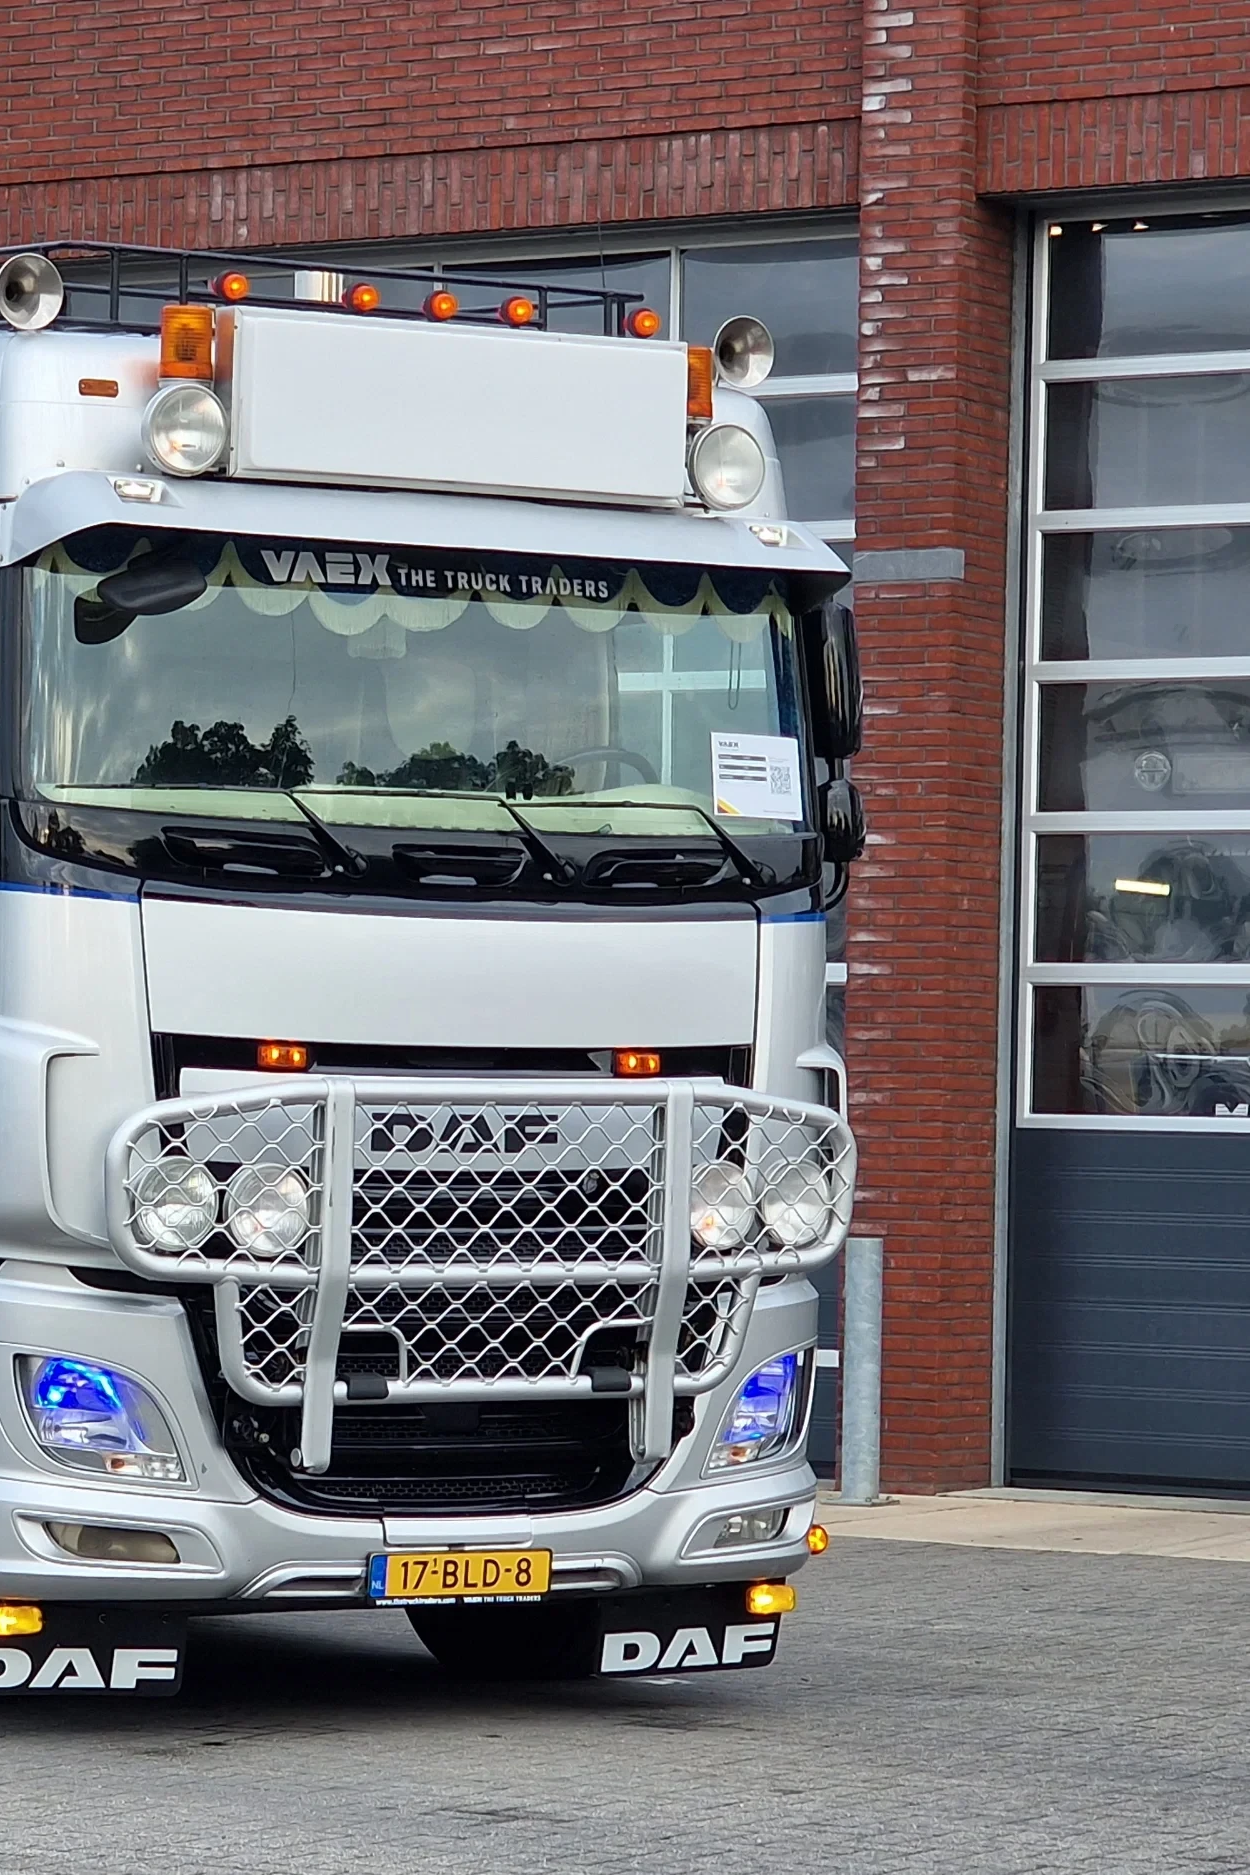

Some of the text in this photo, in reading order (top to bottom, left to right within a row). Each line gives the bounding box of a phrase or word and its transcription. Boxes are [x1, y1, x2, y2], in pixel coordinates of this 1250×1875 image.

[260, 550, 609, 598] VAEX THE TRUCK TRADERS
[371, 1112, 558, 1153] DAF
[372, 1581, 385, 1591] NL
[600, 1622, 775, 1673] DAF
